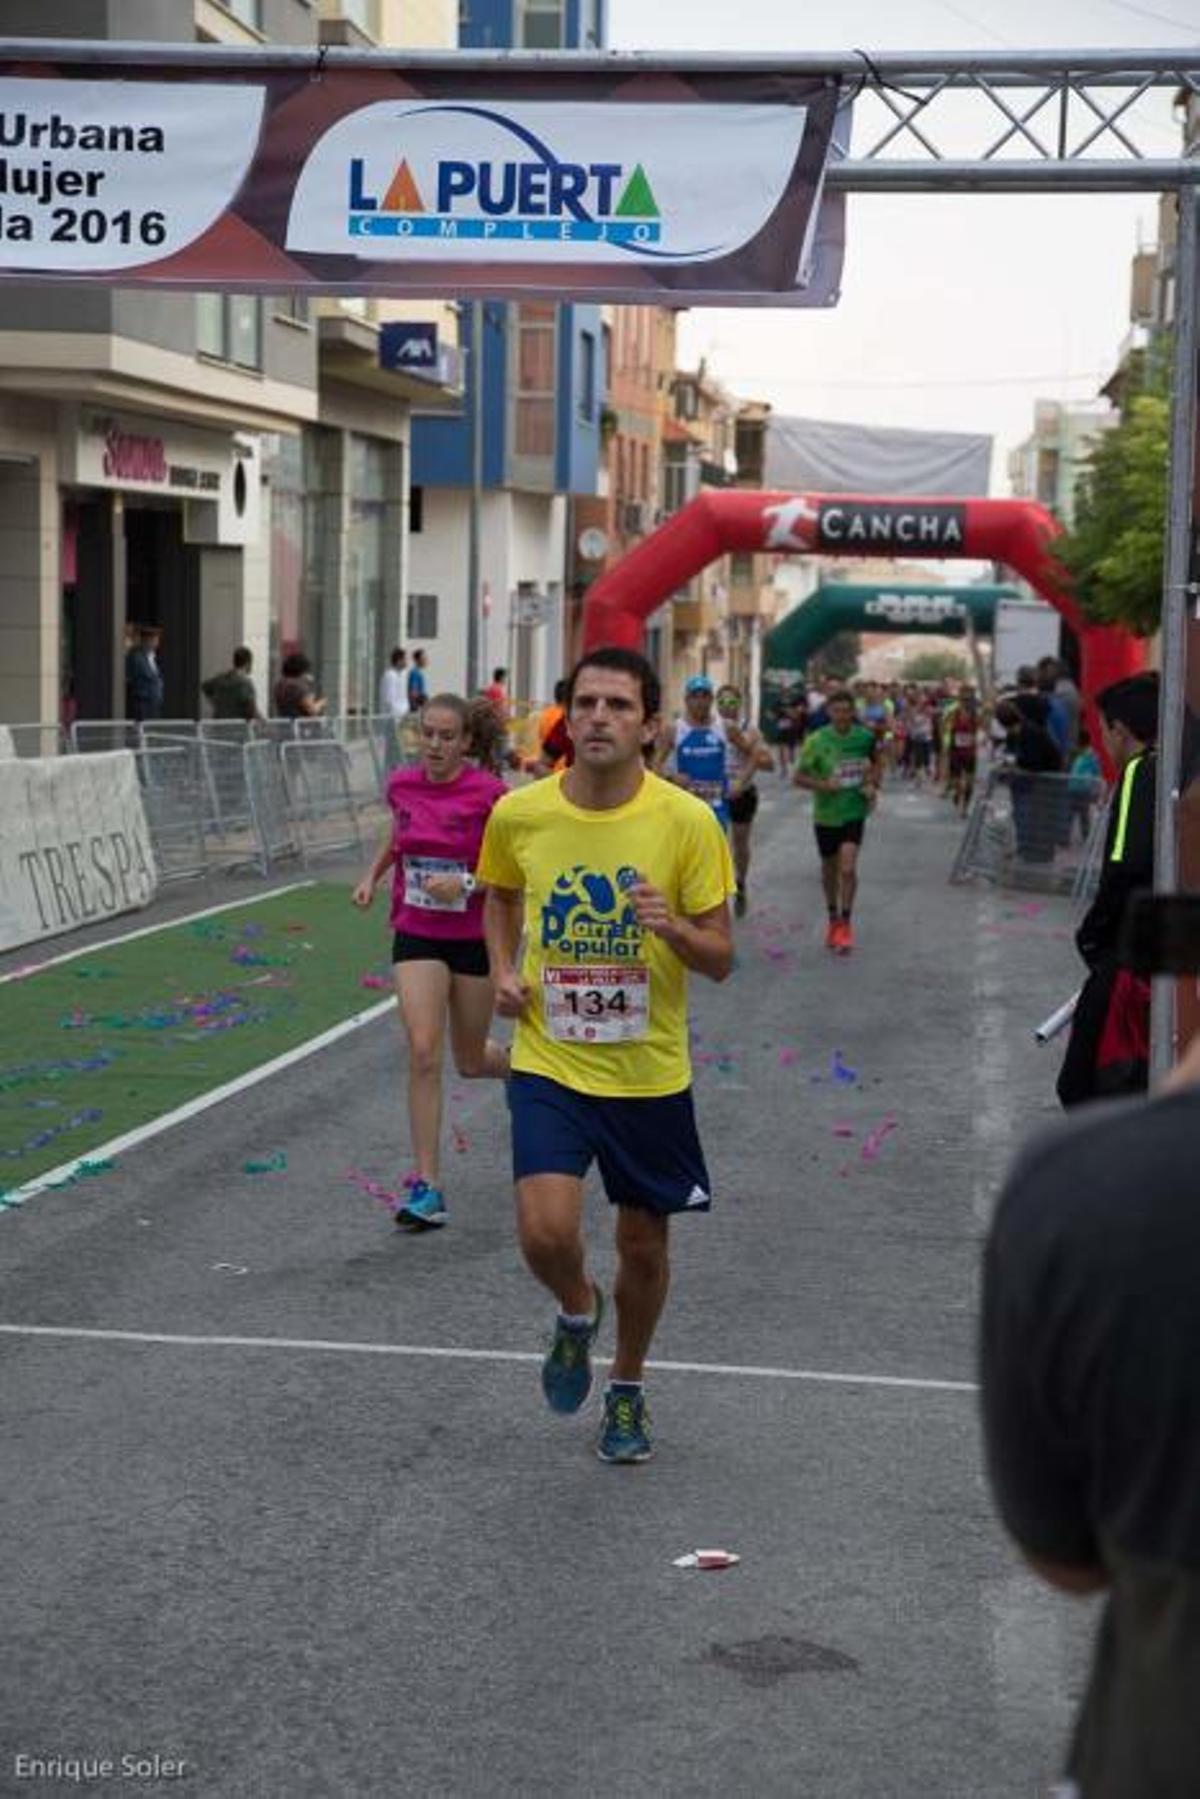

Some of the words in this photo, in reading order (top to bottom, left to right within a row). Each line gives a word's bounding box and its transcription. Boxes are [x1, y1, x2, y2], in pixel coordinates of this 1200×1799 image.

[0, 113, 164, 153] Urbana
[350, 157, 426, 212] LA
[438, 160, 661, 217] PUERTA
[50, 208, 166, 246] 2016
[358, 219, 652, 243] COMPLEJO
[821, 509, 962, 542] CANCHA
[564, 989, 626, 1015] 134
